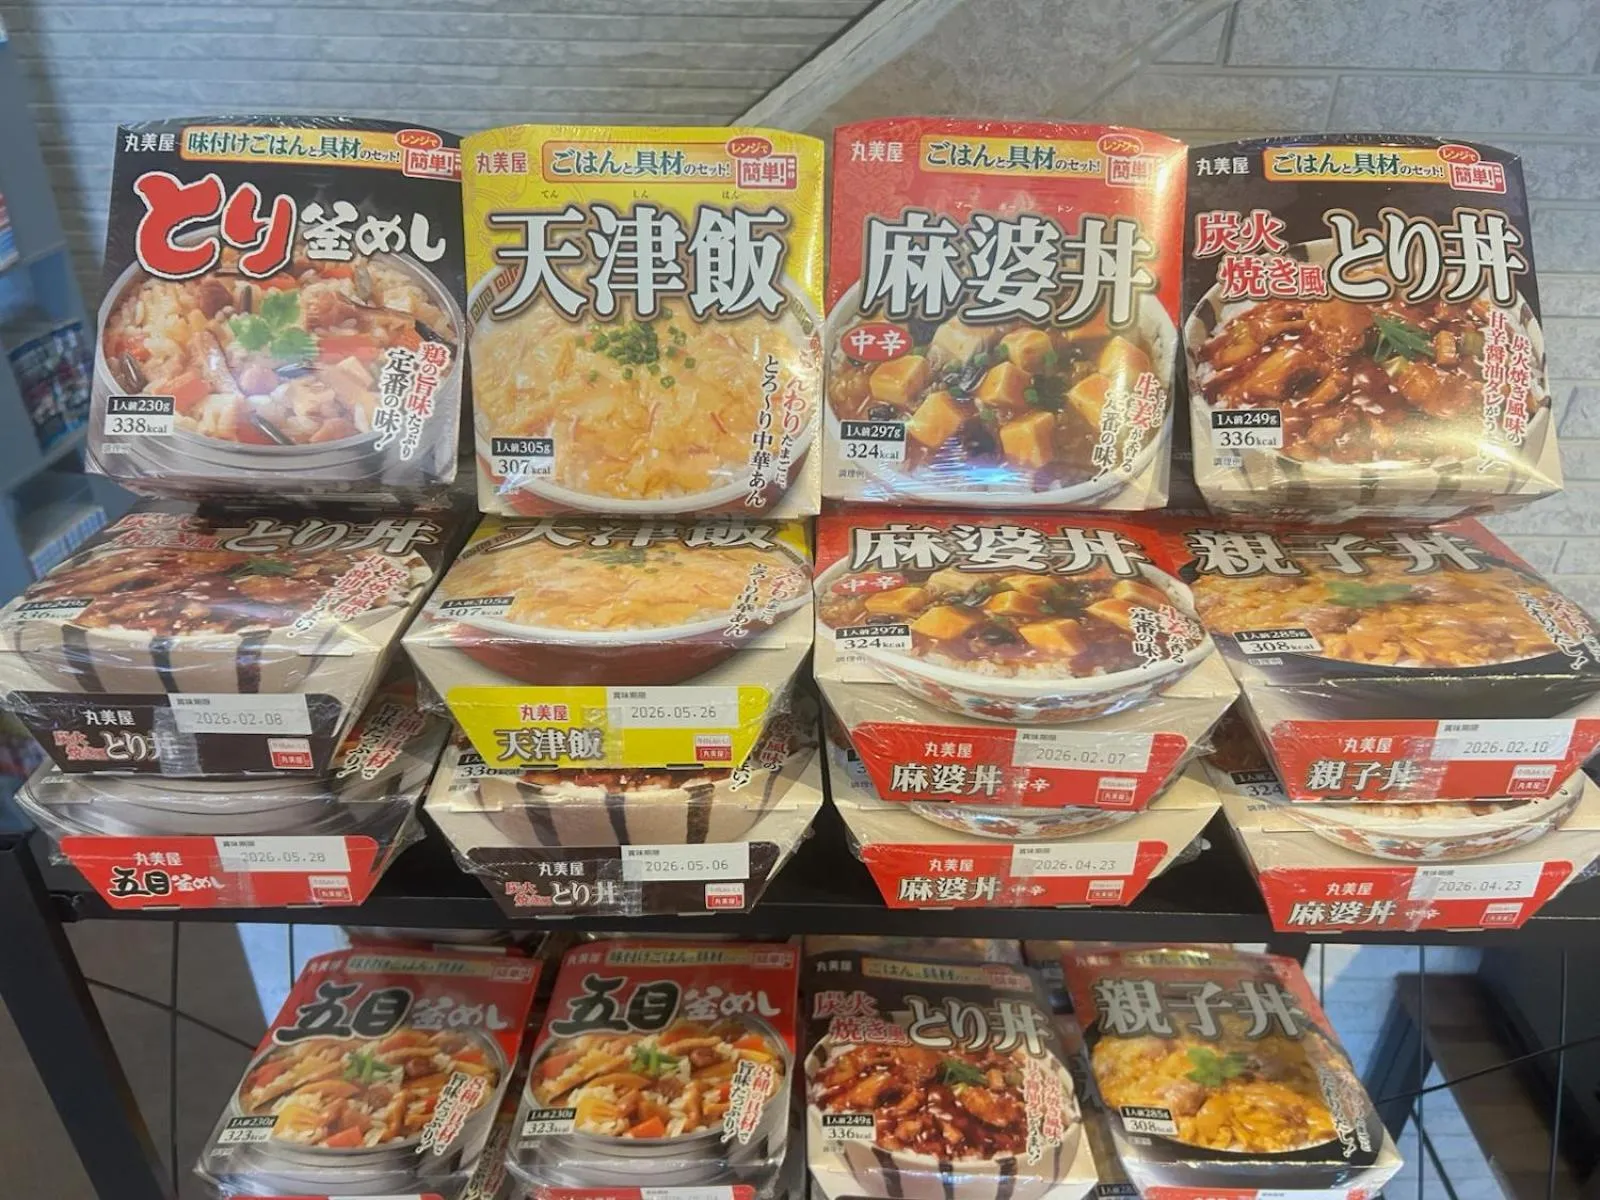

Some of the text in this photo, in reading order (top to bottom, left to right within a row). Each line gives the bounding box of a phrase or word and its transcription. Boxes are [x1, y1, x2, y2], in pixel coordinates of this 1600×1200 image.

[124, 133, 175, 152] 丸美屋
[188, 131, 400, 164] 味付けごはんと具材のセット!
[400, 131, 438, 147] レンジで
[731, 142, 769, 154] レンジで
[851, 140, 904, 162] 丸美屋
[925, 142, 1101, 172] ごはんと具材のセット!
[410, 153, 452, 174] 簡単!
[476, 152, 527, 174] 丸美屋
[552, 150, 731, 176] ごはんと具材のセット!
[743, 162, 785, 182] 簡単!
[1196, 157, 1250, 176] 丸美屋
[1273, 153, 1443, 178] ごはんと具材のセット!
[1455, 166, 1494, 186] 簡単!
[1197, 211, 1287, 256] 炭火
[486, 204, 788, 318] 天津飯
[861, 209, 1155, 325] 麻婆丼
[1326, 209, 1526, 305] とり丼
[1220, 257, 1327, 298] 焼き風
[850, 329, 906, 356] 中辛
[374, 350, 415, 449] 定番の味!
[1480, 311, 1508, 470] 甘辛醤油タレがう!
[1506, 335, 1531, 445] 炭火焼き風味の
[112, 418, 167, 433] 338kcal
[1220, 431, 1277, 446] 336kcal
[846, 443, 899, 458] 324kcal
[498, 459, 551, 474] 307kcal
[226, 518, 437, 554] とり丼
[852, 525, 1143, 574] 麻婆丼
[1189, 529, 1487, 575] 親子丼
[842, 575, 900, 593] 中辛
[83, 709, 135, 726] 丸美屋
[195, 711, 284, 726] 2026.02.08
[520, 705, 568, 721] 丸美屋
[632, 705, 717, 719] 2026.05.26
[495, 728, 603, 761] 天津飯
[924, 742, 973, 759] 丸美屋
[1343, 737, 1393, 753] 丸美屋
[1462, 741, 1550, 754] 2026.02.10
[890, 763, 1003, 796] 麻婆丼
[1306, 760, 1420, 791] 親子丼
[134, 852, 183, 866] 丸美屋
[539, 862, 584, 876] 丸美屋
[645, 860, 729, 872] 2026.05.06
[929, 859, 974, 872] 丸美屋
[1035, 859, 1117, 871] 2026.04.23
[108, 866, 226, 897] 五目釜めし
[898, 876, 1000, 901] 麻婆丼
[1326, 882, 1374, 896] 丸美屋
[1438, 880, 1522, 892] 2026.04.23
[1287, 900, 1398, 926] 麻婆丼
[273, 980, 508, 1045] 五目釜めし
[550, 973, 781, 1037] 五目釜めし
[1095, 978, 1304, 1038] 親子丼
[907, 996, 1050, 1055] とり丼
